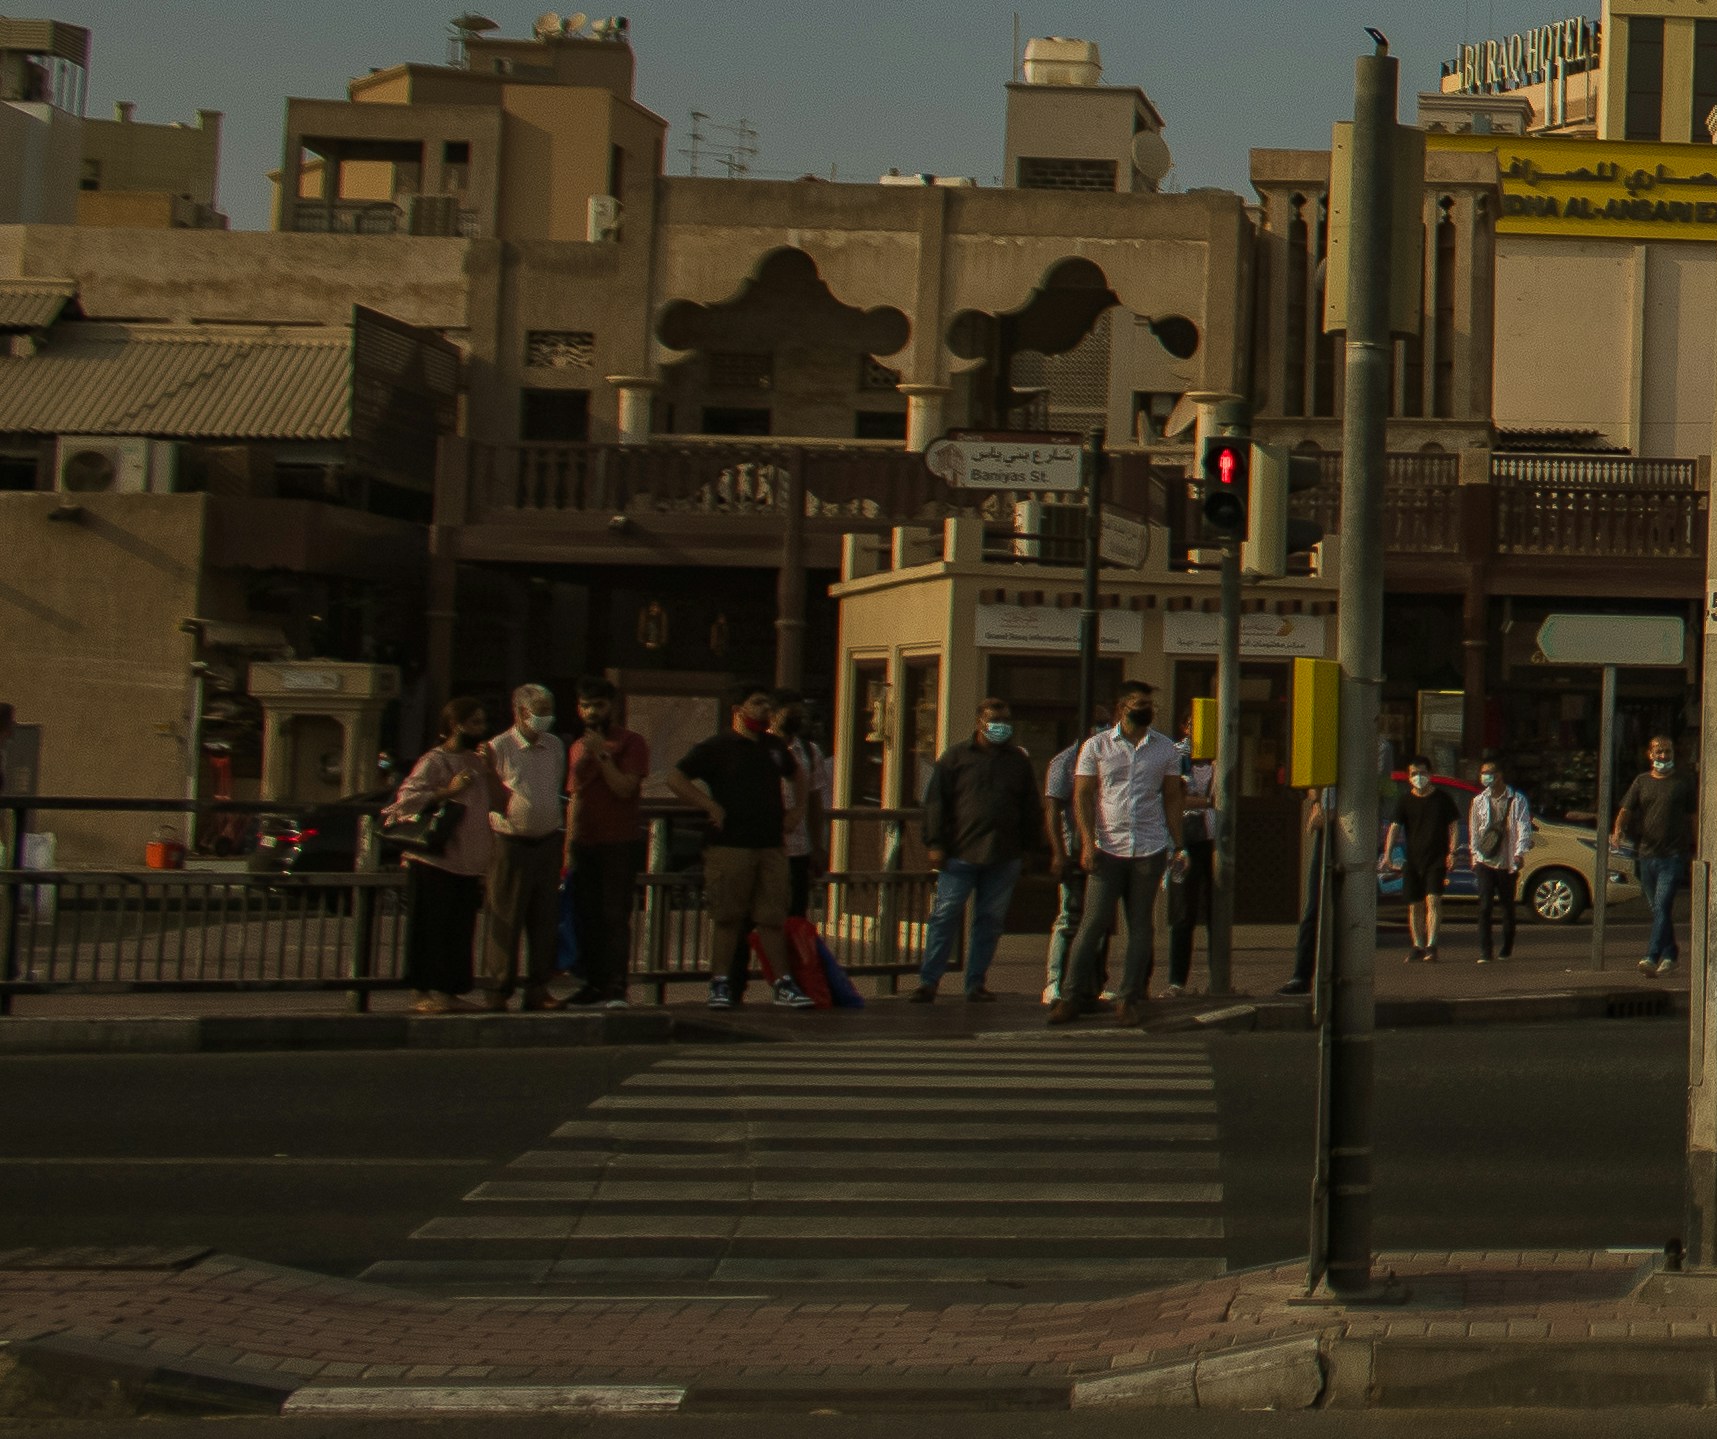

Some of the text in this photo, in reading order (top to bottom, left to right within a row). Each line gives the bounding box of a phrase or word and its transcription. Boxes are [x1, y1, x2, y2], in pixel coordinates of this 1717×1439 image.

[1464, 15, 1587, 88] BURAQ HOTEL
[1563, 197, 1693, 224] AL-ANSARI
[1031, 446, 1075, 465] شارع
[970, 468, 1026, 483] Baniyas
